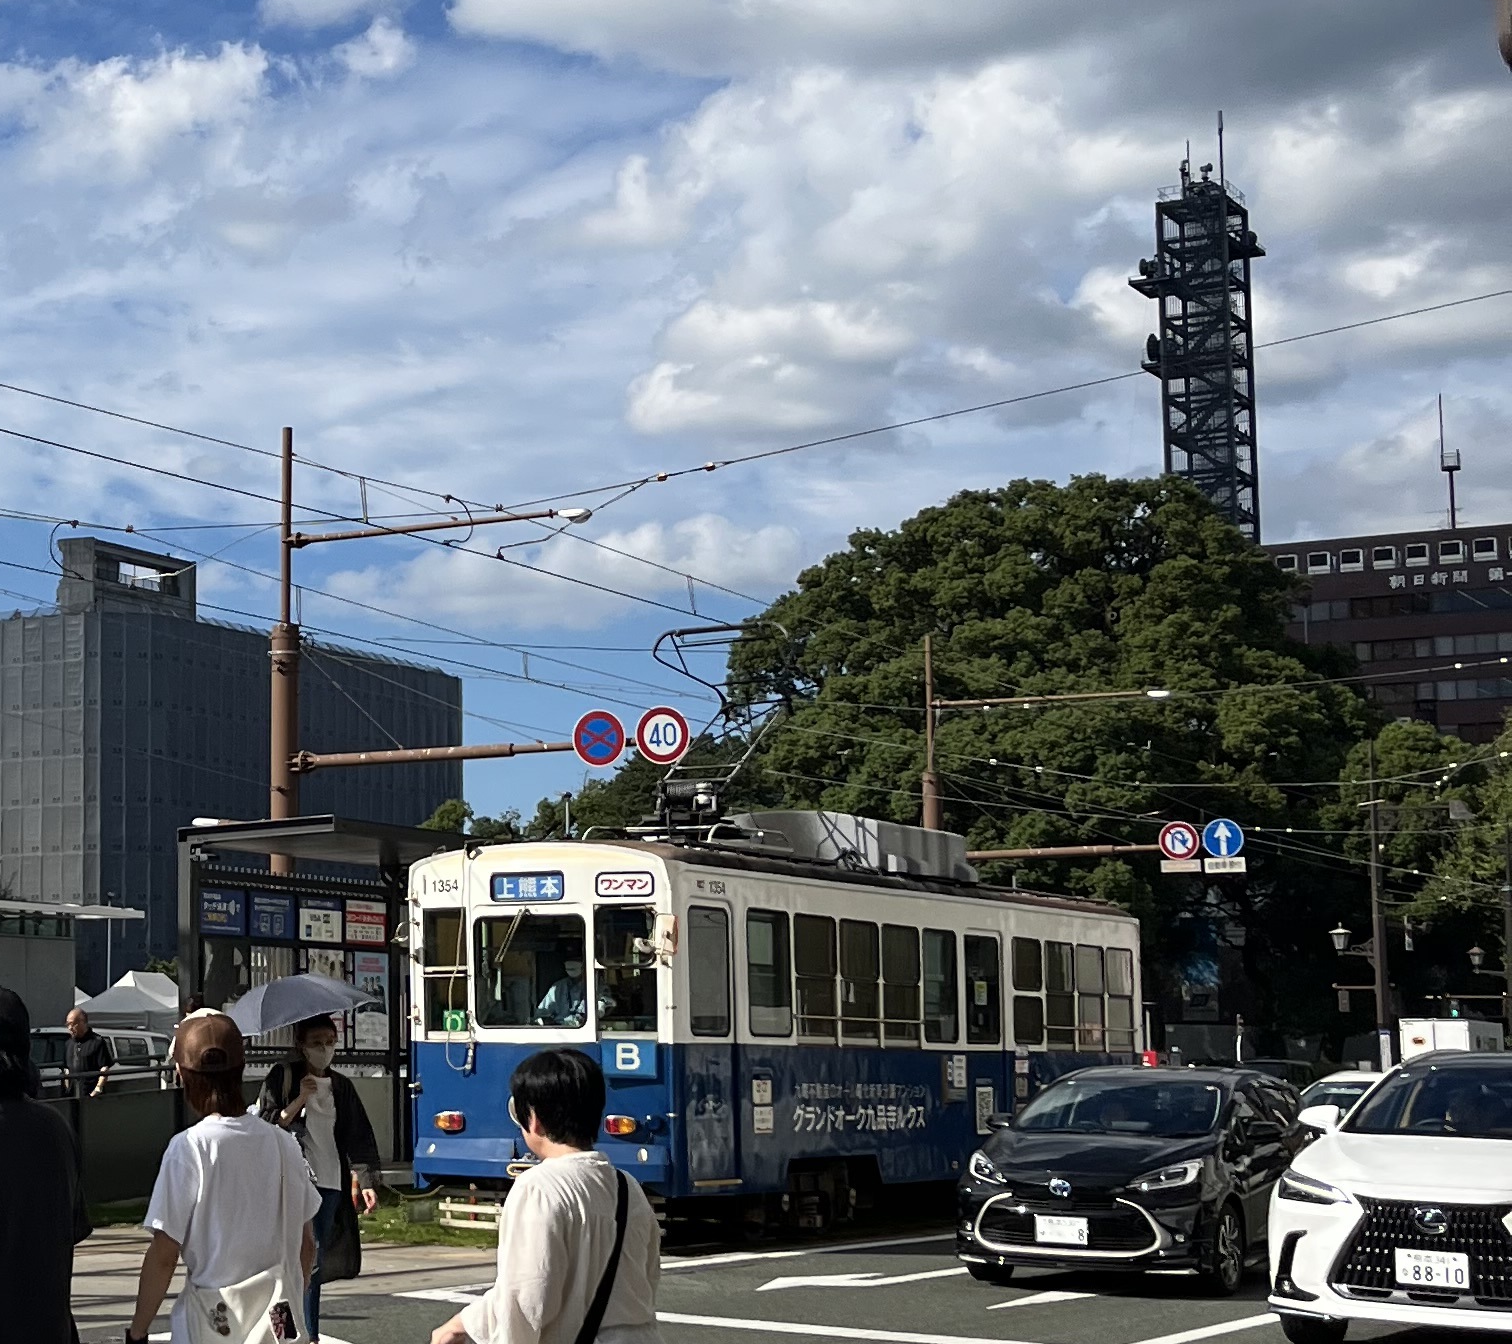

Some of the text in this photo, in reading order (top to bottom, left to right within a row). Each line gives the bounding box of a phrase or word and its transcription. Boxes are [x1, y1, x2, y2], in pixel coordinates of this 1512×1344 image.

[1389, 570, 1468, 590] 朝日新聞
[649, 723, 677, 747] 40
[432, 878, 460, 893] 1354
[496, 876, 560, 899] 上熊本
[600, 878, 649, 891] ワンマン
[615, 1042, 641, 1071] B
[793, 1104, 926, 1133] グランドオーク九品寺ルクス
[1412, 1264, 1465, 1285] 88-10
